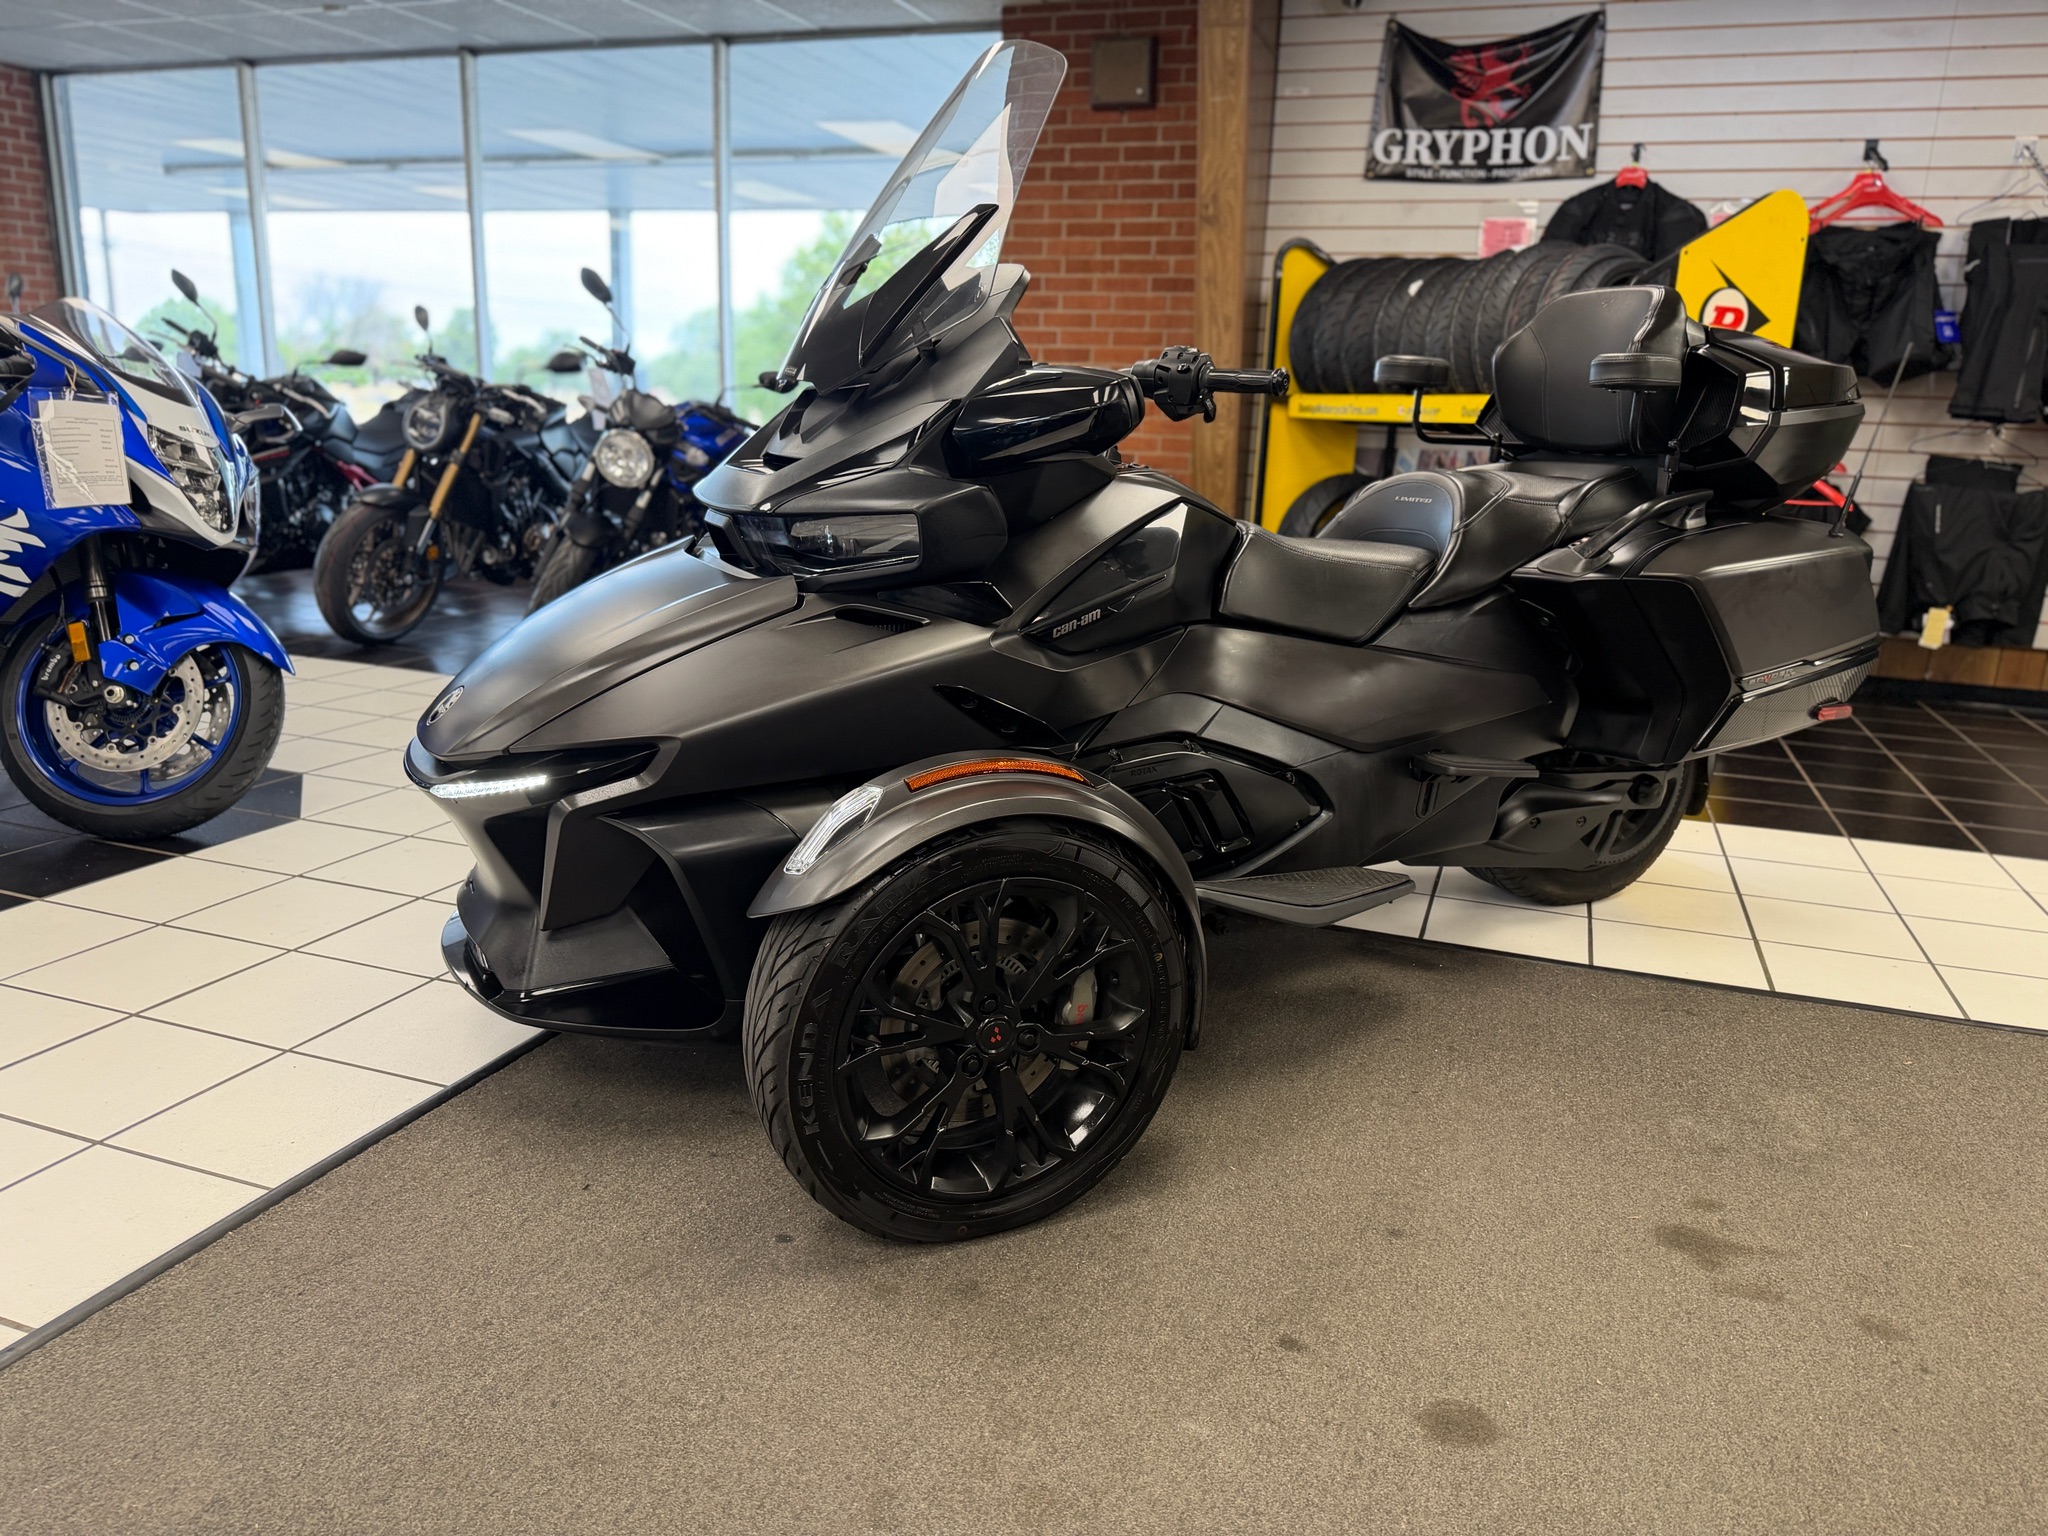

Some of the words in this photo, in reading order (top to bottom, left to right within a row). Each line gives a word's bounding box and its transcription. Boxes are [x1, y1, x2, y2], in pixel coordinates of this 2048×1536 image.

[1372, 122, 1594, 166] GRYPHON
[1709, 305, 1745, 331] D
[1394, 495, 1433, 504] LIMITED
[1052, 608, 1101, 639] can-am
[40, 654, 61, 680] brembo
[796, 987, 834, 1136] KENDA
